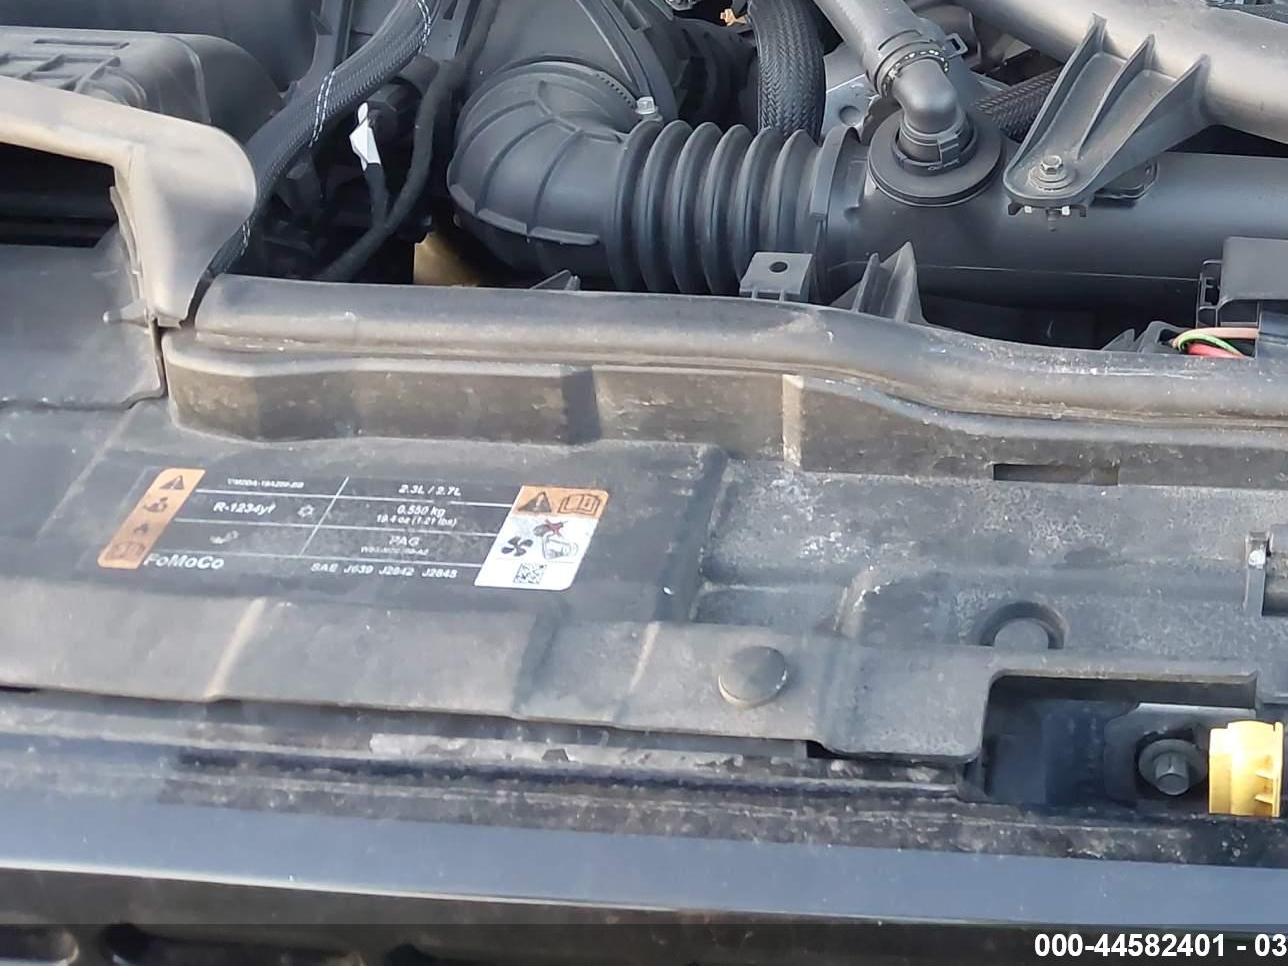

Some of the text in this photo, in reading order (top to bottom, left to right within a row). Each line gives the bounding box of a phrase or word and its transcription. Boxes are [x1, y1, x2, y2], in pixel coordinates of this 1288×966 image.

[398, 484, 425, 495] 2.3L
[435, 485, 461, 496] 2.7L
[213, 501, 276, 516] R-1234yf
[430, 505, 446, 518] kg
[389, 535, 420, 546] PAG
[143, 553, 225, 570] FoMoCo
[344, 564, 374, 574] J639
